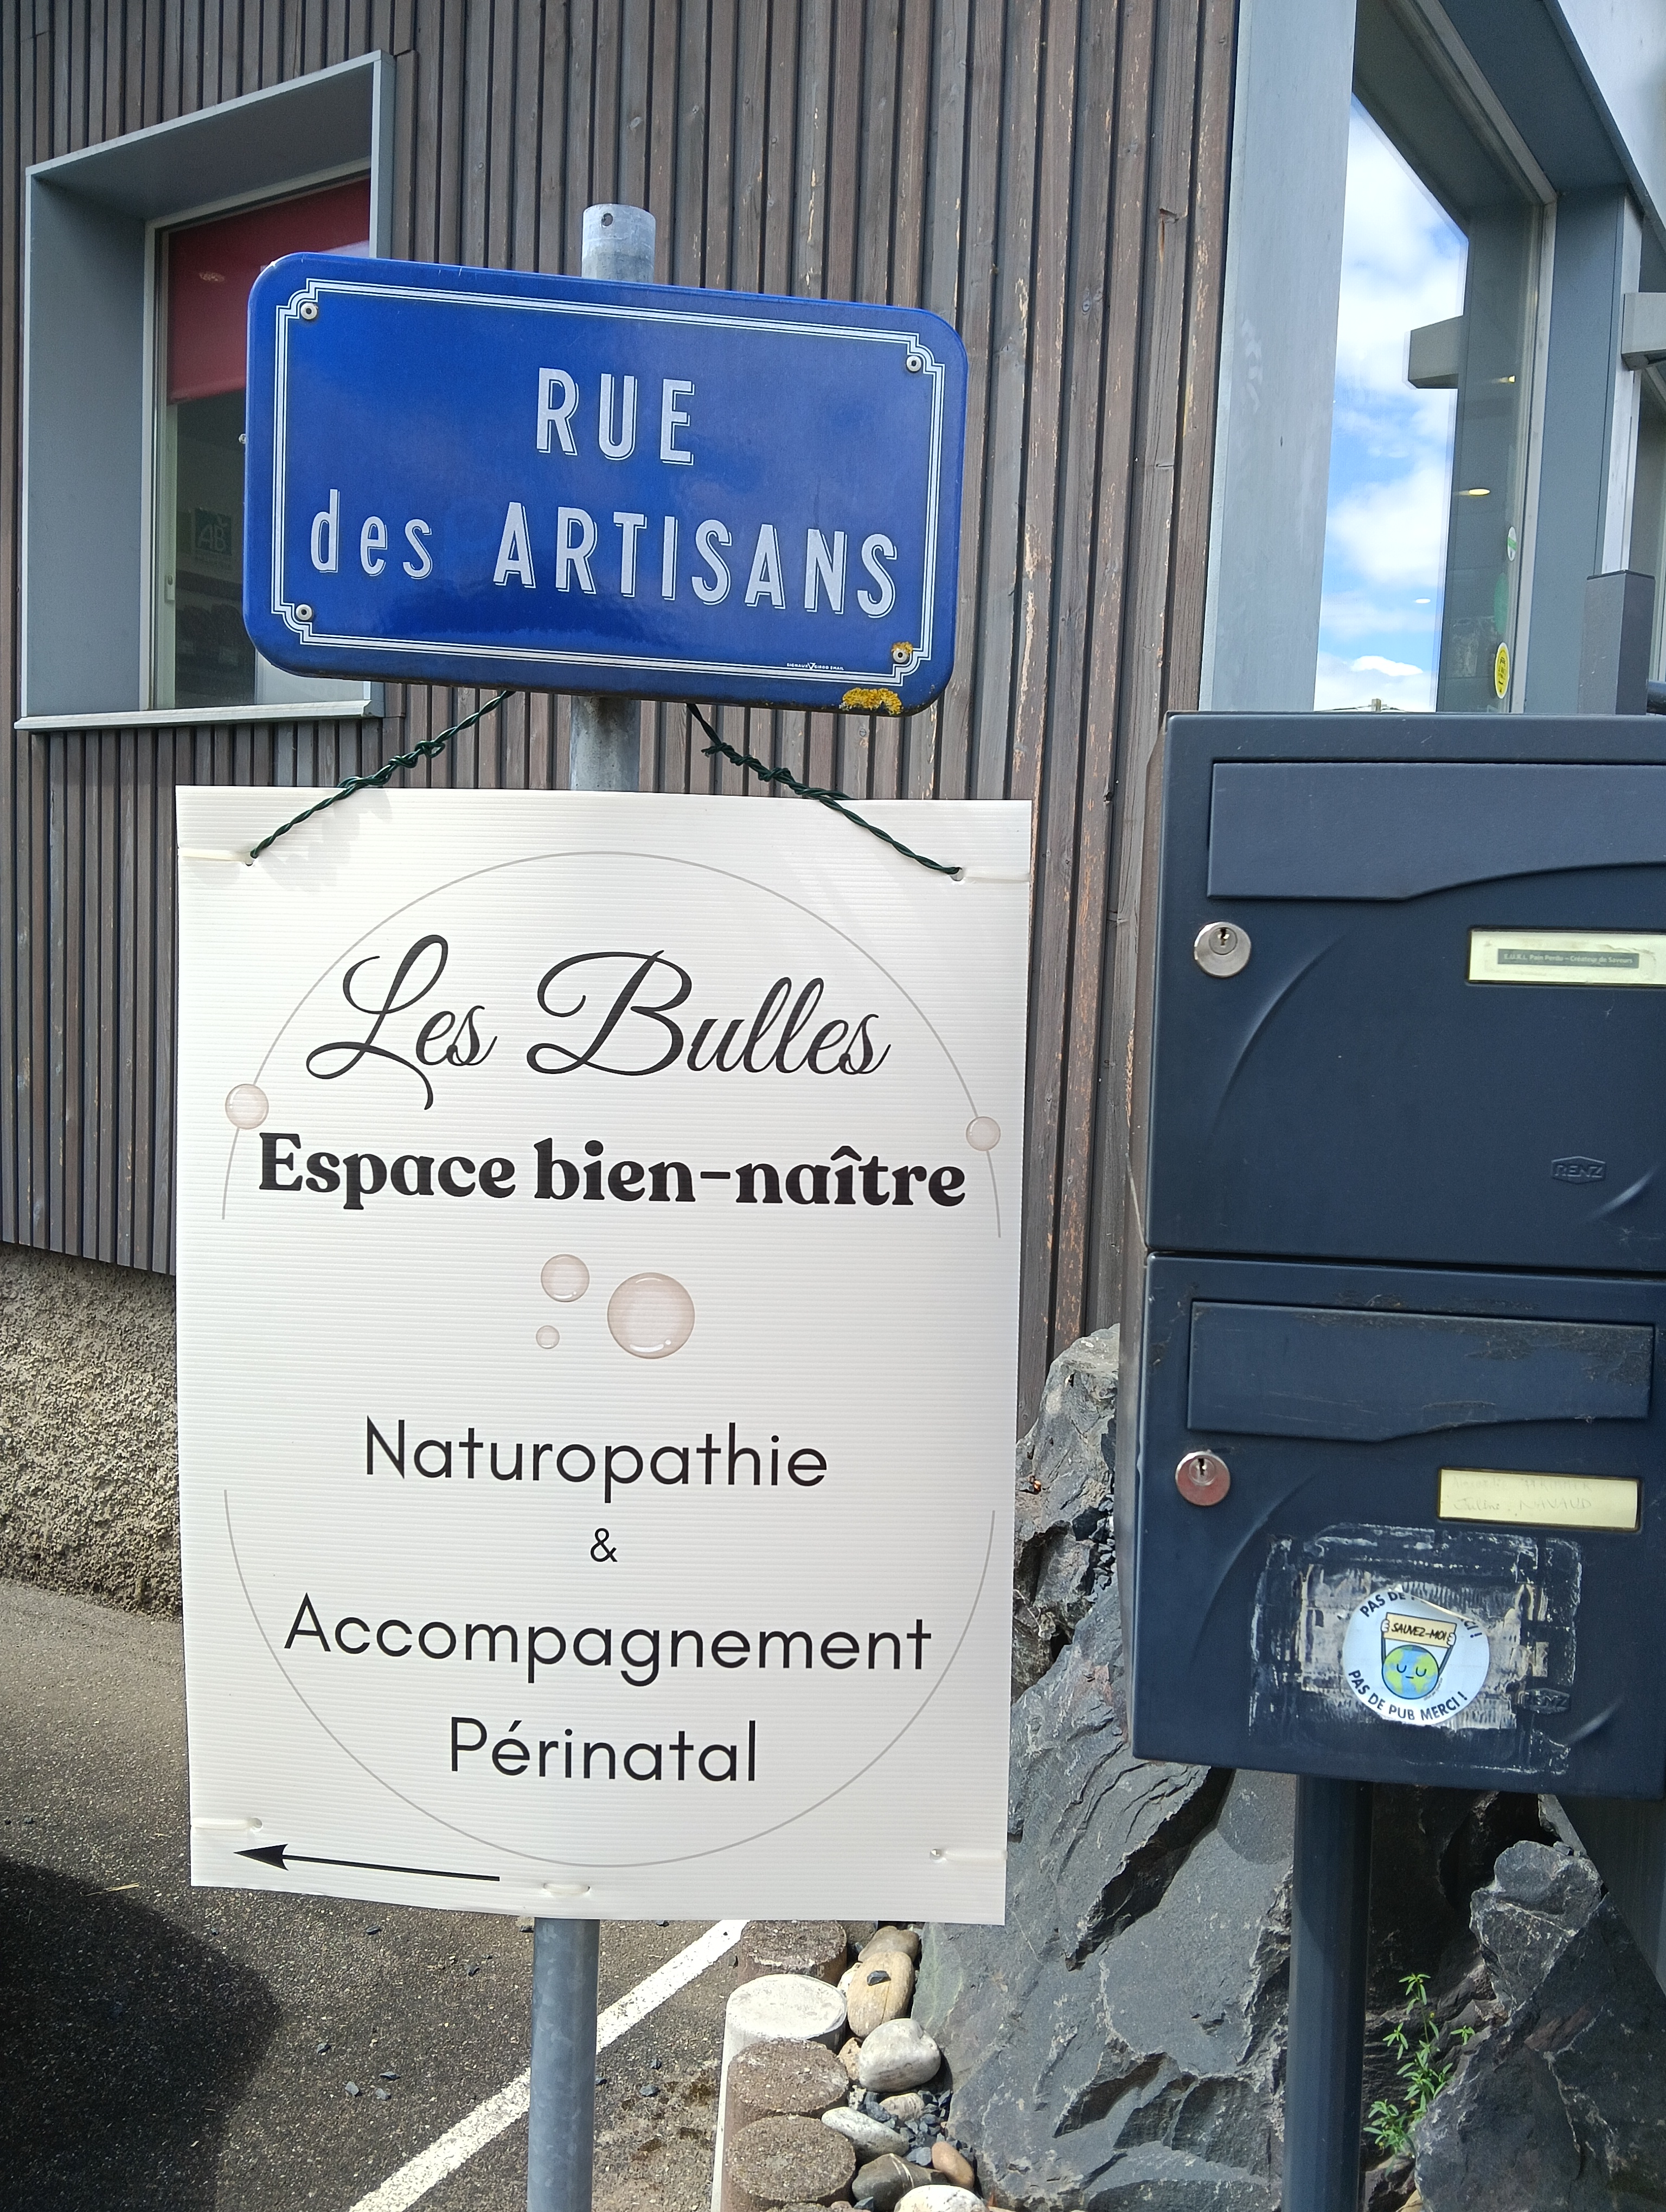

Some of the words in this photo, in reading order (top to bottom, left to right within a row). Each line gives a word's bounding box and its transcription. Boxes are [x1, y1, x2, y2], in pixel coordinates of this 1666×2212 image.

[536, 367, 695, 466] RUE
[311, 488, 433, 580] des
[493, 501, 898, 619] ARTISANS
[306, 934, 498, 1110] Les
[526, 950, 891, 1076] Bulles
[259, 1132, 516, 1210] Espace
[533, 1137, 965, 1207] bien-naître
[1554, 1165, 1603, 1178] RENZ
[367, 1416, 827, 1503] Naturopathie
[590, 1528, 618, 1562] &
[284, 1592, 932, 1687] Accompagnement
[1360, 1594, 1385, 1617] PAS
[1391, 1623, 1448, 1641] SAUVEZ-MOI
[1348, 1670, 1370, 1695] PAS
[1368, 1693, 1386, 1711] DE
[1388, 1704, 1415, 1721] PUB
[1420, 1696, 1460, 1721] MERCI
[451, 1716, 755, 1782] Périnatal
